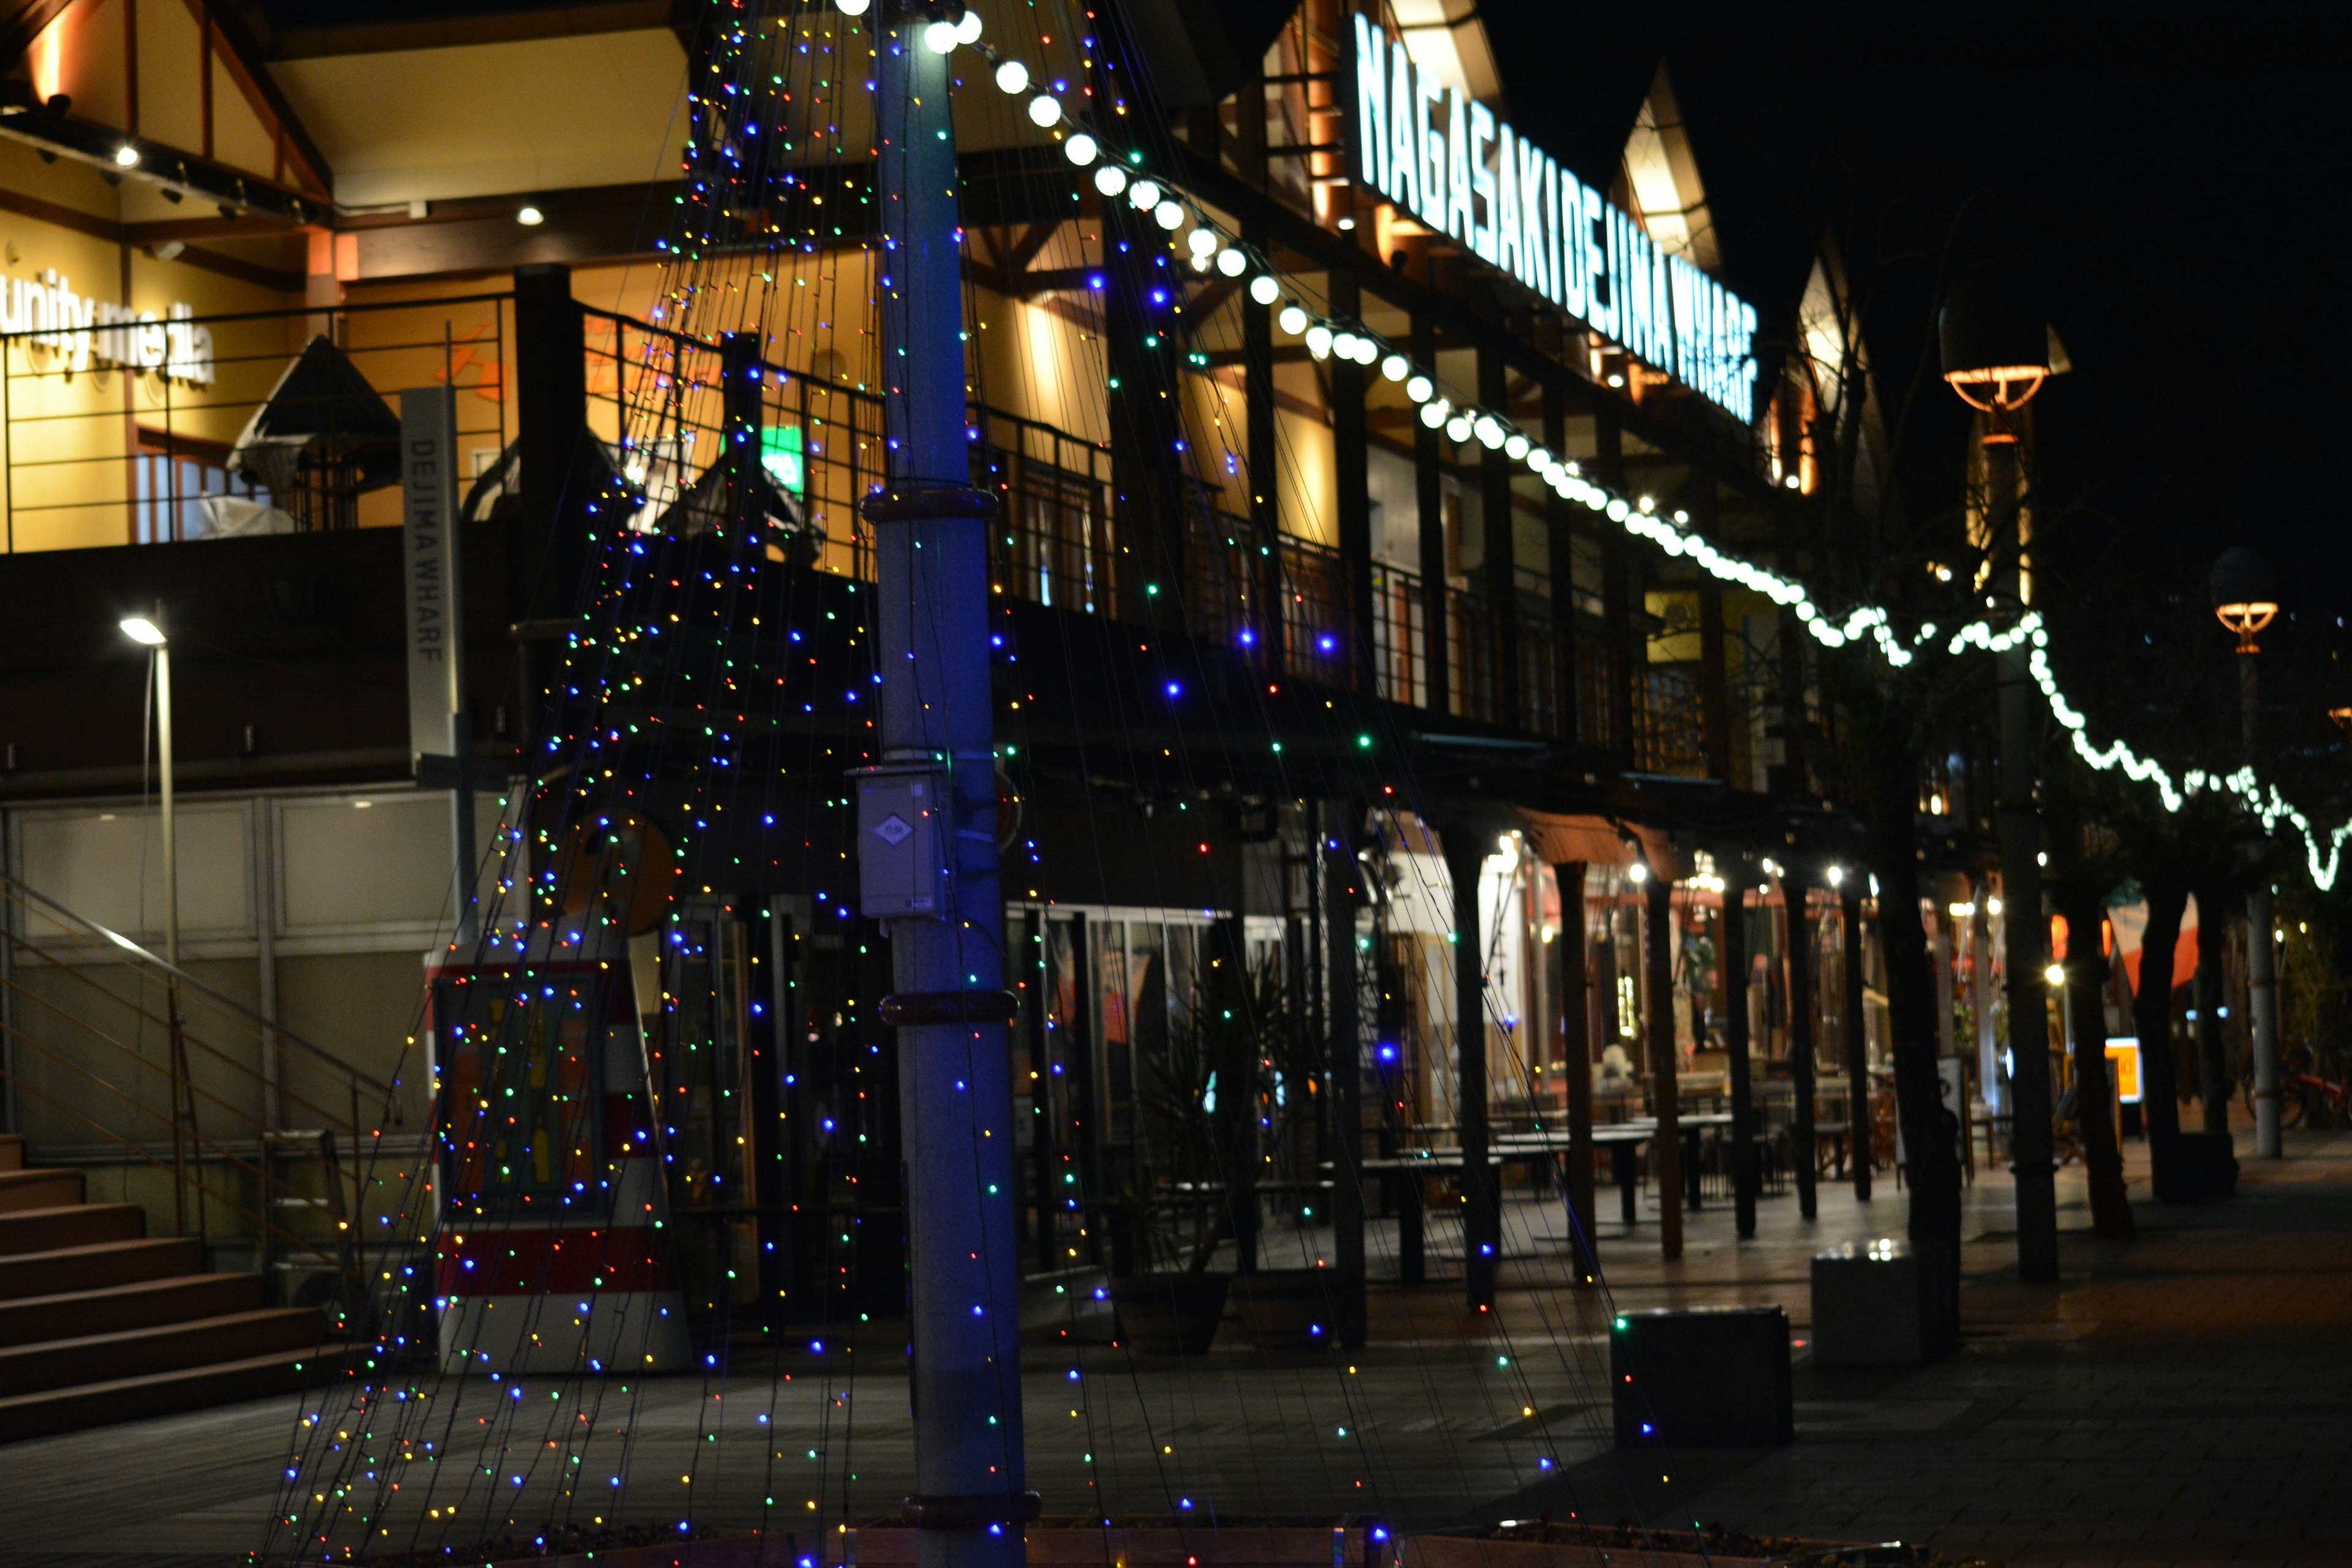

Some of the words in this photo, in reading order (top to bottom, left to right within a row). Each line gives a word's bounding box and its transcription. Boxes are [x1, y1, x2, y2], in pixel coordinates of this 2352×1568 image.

[1355, 12, 1562, 306] NAGASAKI
[1561, 167, 1674, 377] DEJIMA
[1670, 252, 1758, 426] WHARF
[411, 440, 439, 552] DEJIMA
[415, 557, 442, 662] WHARF
